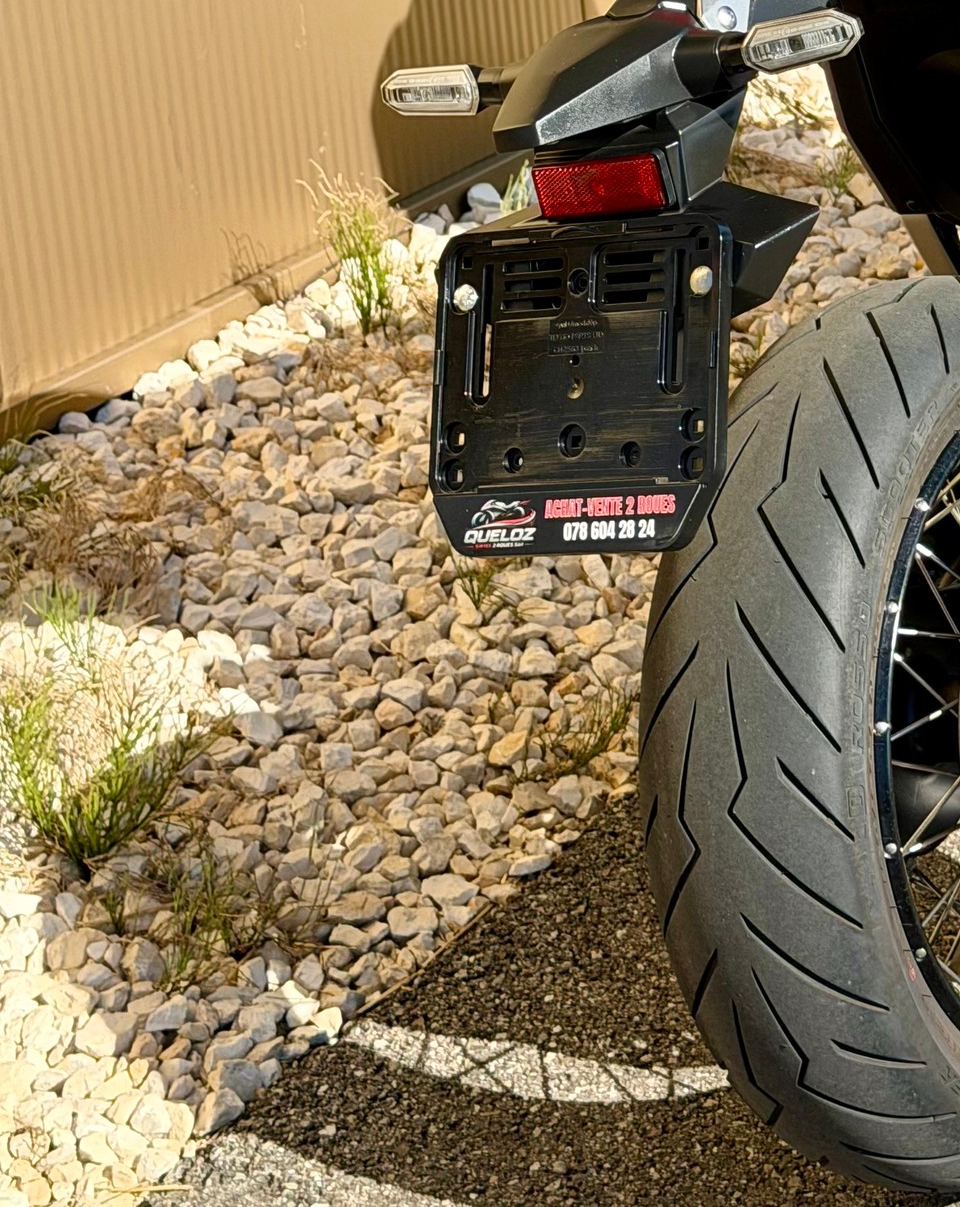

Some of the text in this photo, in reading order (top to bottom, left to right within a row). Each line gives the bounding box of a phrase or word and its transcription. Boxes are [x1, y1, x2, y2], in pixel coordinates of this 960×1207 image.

[544, 494, 676, 519] ACHAT-VENTE 2 ROUES
[463, 527, 537, 544] QUELOZ
[563, 518, 656, 541] 078 604 28 24
